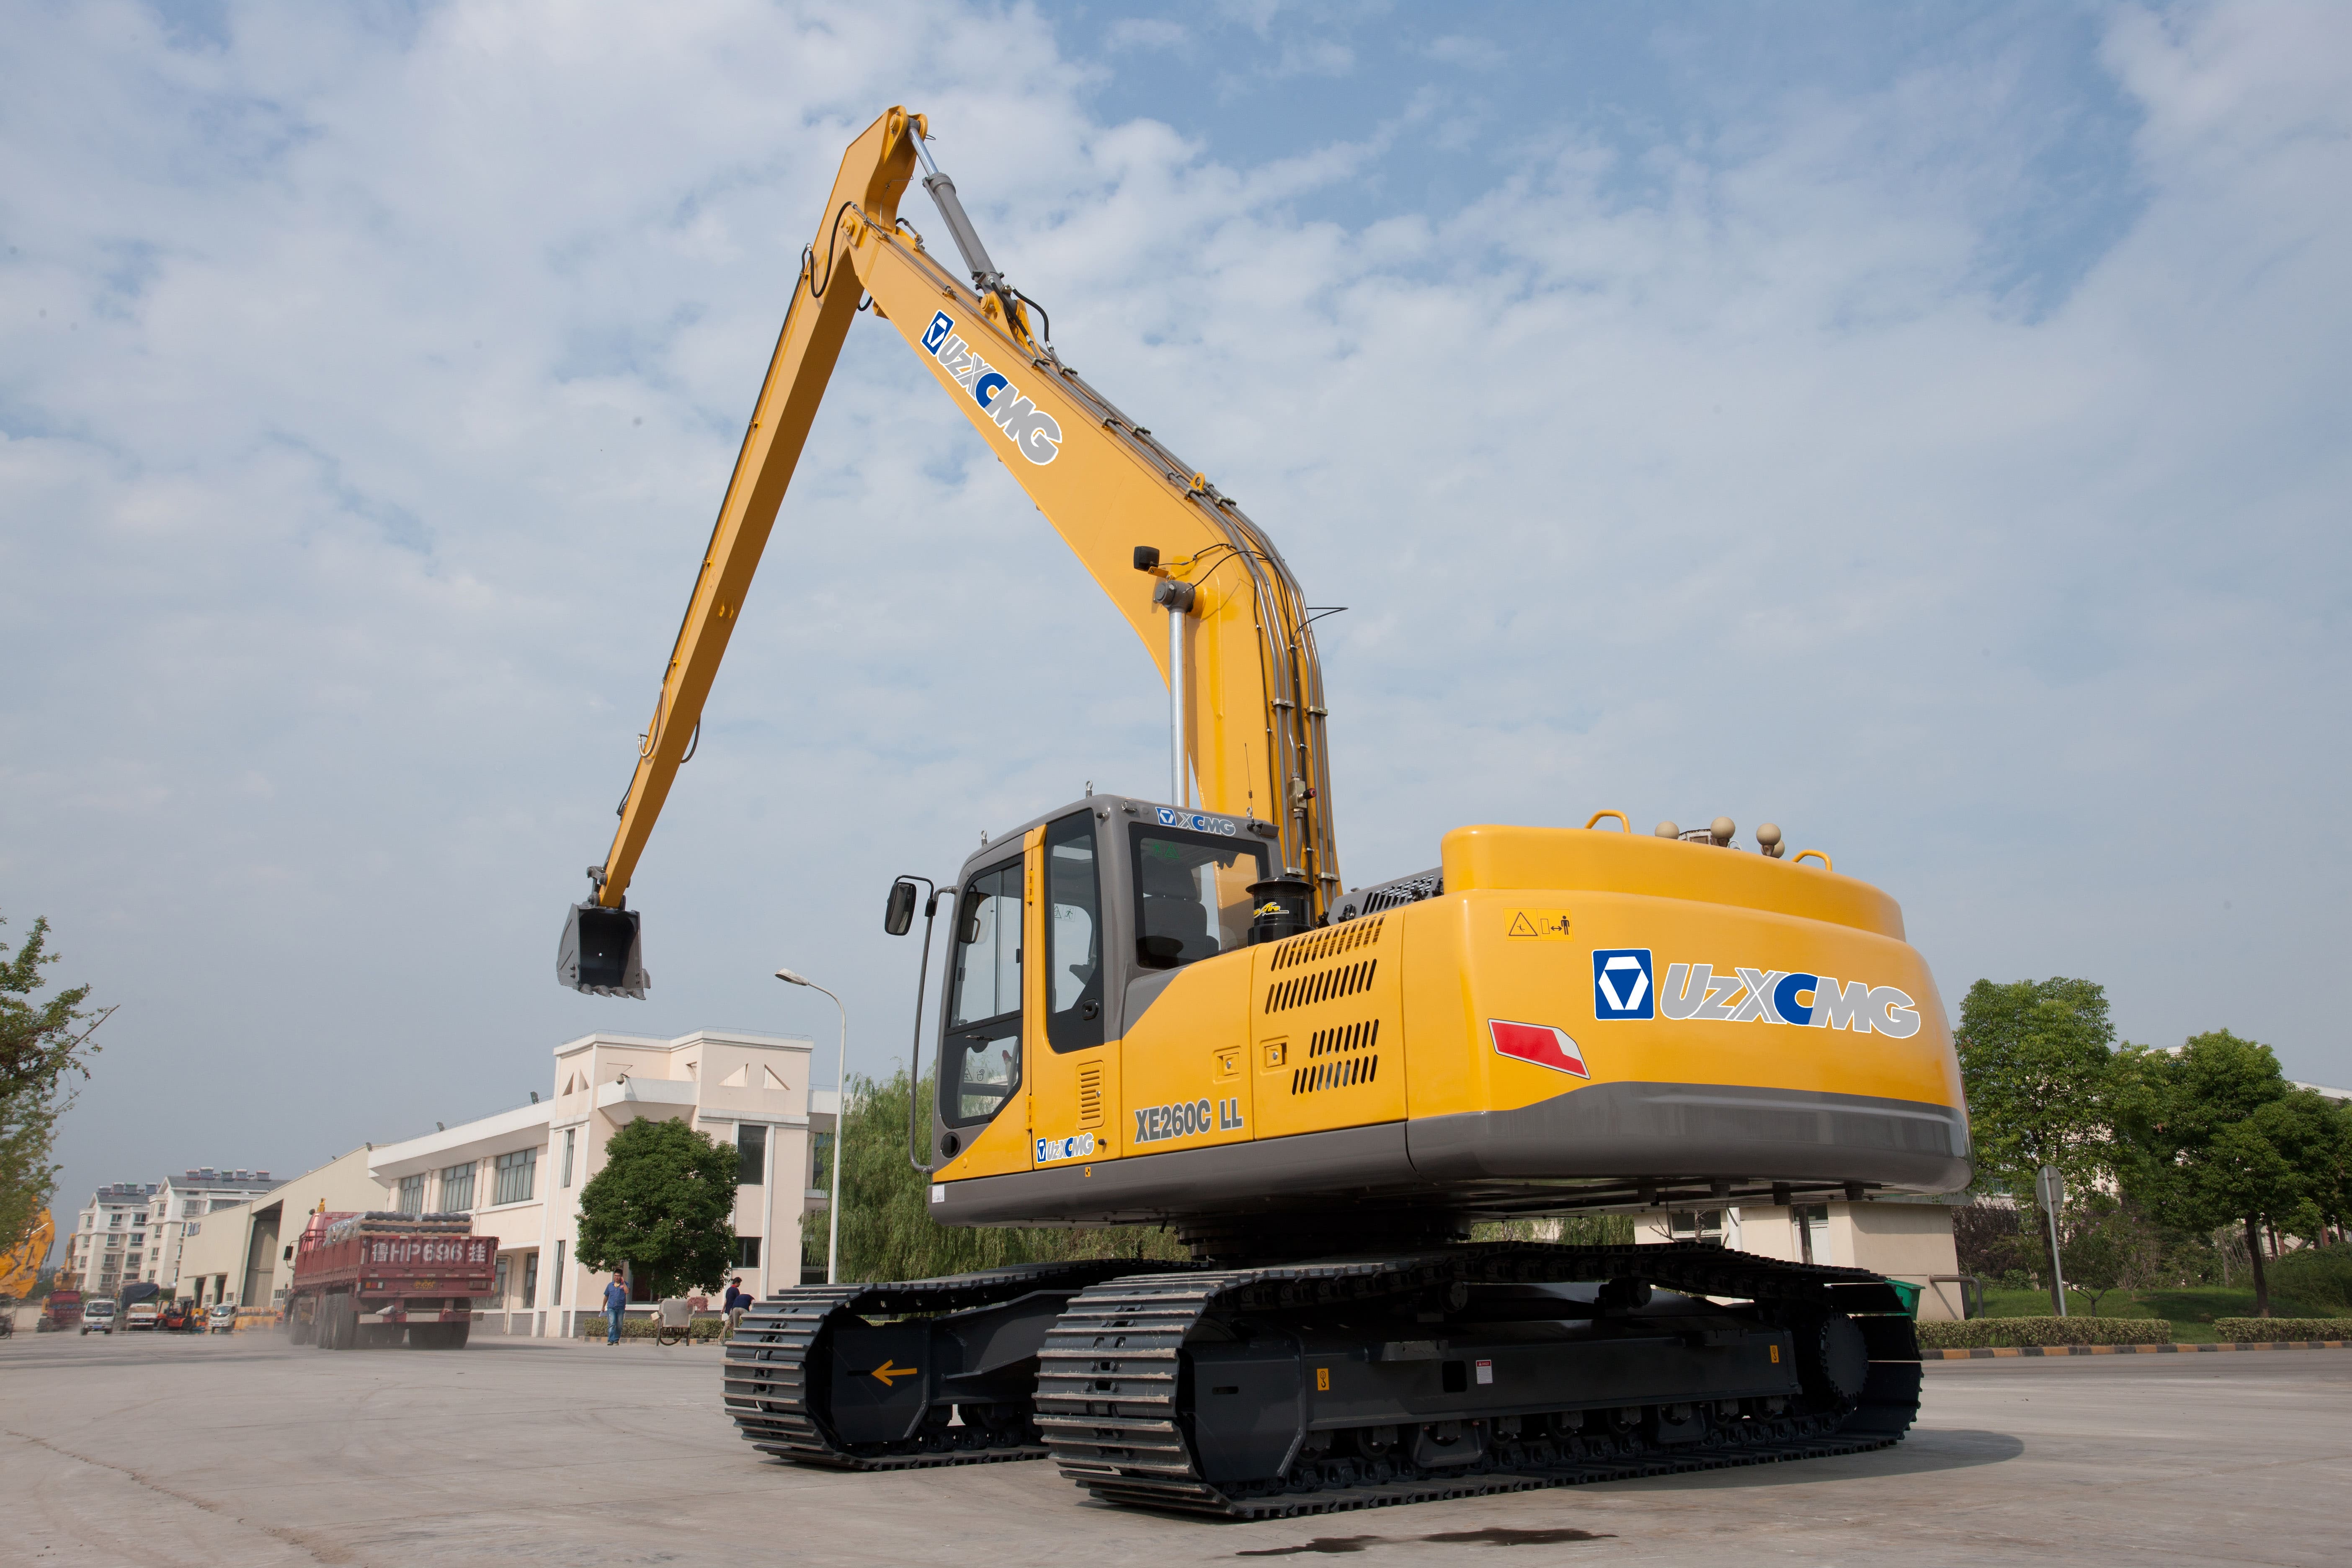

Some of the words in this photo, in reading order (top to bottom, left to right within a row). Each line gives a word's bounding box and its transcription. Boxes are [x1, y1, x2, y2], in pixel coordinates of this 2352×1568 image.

[1177, 812, 1235, 836] XCMG
[1661, 963, 1920, 1039] UzXCMG
[1134, 1098, 1212, 1144] XE260C
[1219, 1098, 1243, 1131] LL
